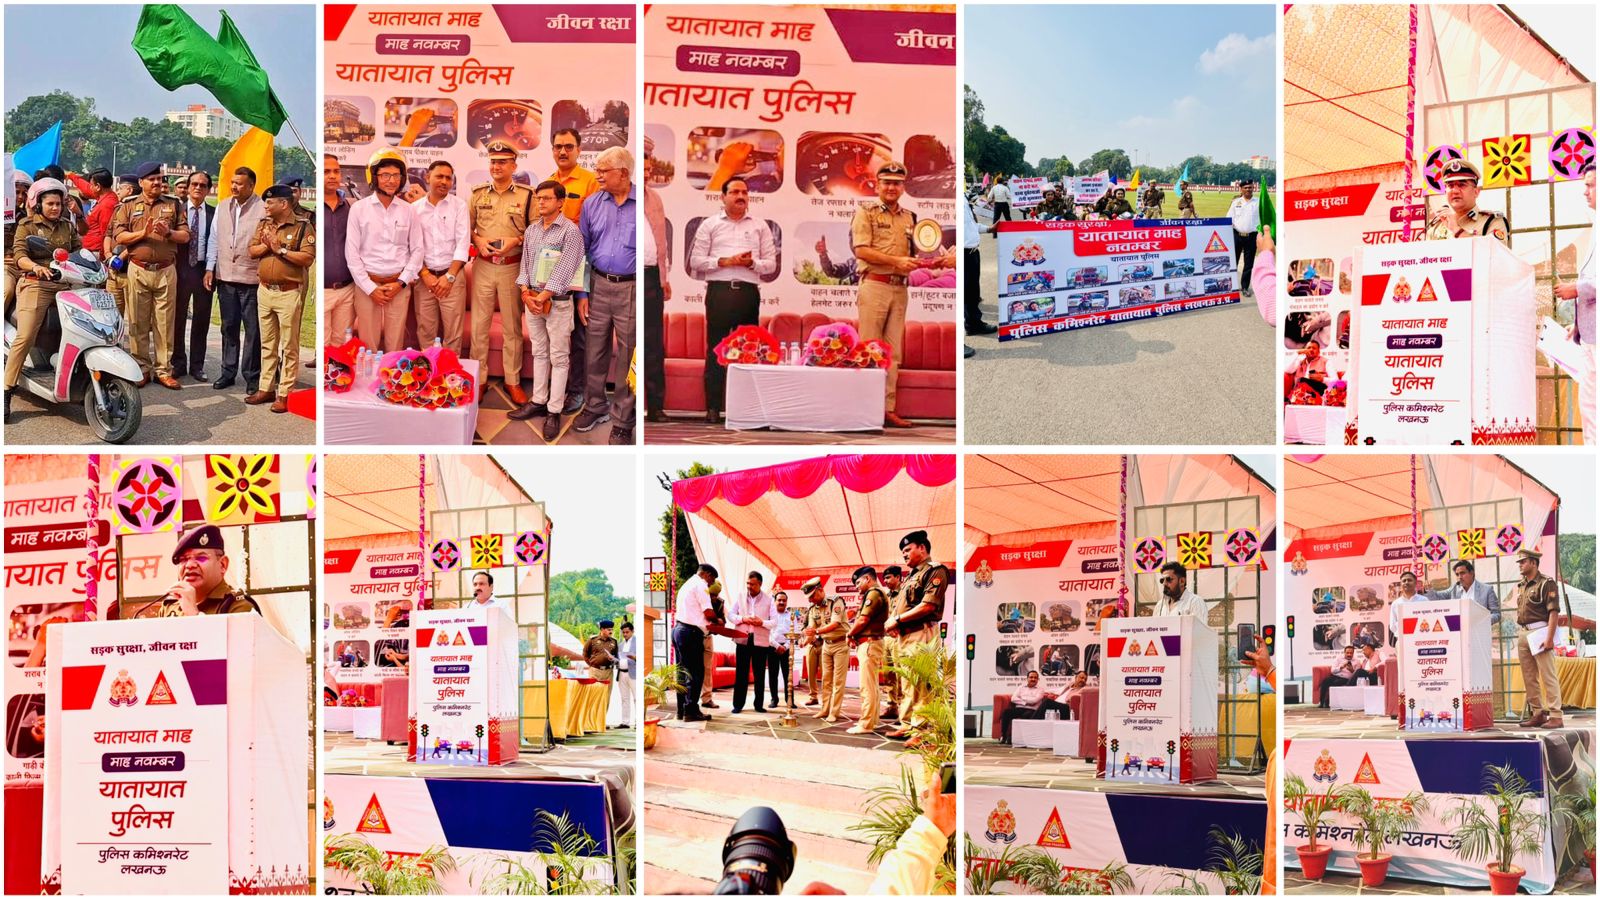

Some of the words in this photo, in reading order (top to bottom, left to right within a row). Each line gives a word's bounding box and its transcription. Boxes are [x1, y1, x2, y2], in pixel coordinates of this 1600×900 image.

[368, 11, 443, 27] यातायात
[447, 12, 482, 28] माह
[545, 13, 595, 30] जीवन
[597, 17, 632, 31] रक्षा
[666, 16, 764, 38] यातायात
[771, 22, 815, 42] माह
[384, 38, 410, 51] माह
[412, 38, 461, 51] नवम्बर
[894, 28, 956, 50] जीवन
[688, 51, 722, 67] माह
[725, 53, 788, 70] नवम्बर
[336, 63, 435, 84] यातायात
[437, 57, 515, 93] पुलिस
[644, 82, 754, 111] ातायात
[759, 79, 856, 122] पुलिस
[582, 136, 609, 144] STOP
[1294, 199, 1318, 211] सड़क
[1320, 195, 1349, 209] सुरक्षा
[1078, 229, 1150, 243] यातायात
[1153, 228, 1183, 239] माह
[1105, 241, 1162, 253] नवम्बर
[1140, 253, 1160, 262] पुलिस
[1009, 323, 1049, 339] पुलिस
[1052, 313, 1106, 331] कमिश्नरेट
[1110, 307, 1152, 322] यातायात
[1155, 303, 1182, 317] पुलिस
[1184, 298, 1216, 310] लखनऊ
[1382, 318, 1425, 330] यातायात
[1427, 317, 1448, 329] माह
[1392, 338, 1407, 346] माह
[1408, 337, 1436, 346] नवम्बर
[1384, 354, 1444, 368] यातायात
[1390, 371, 1435, 395] पुलिस
[1383, 402, 1404, 414] पुलिस
[1406, 402, 1444, 413] कमिश्नरेट
[1397, 415, 1429, 424] लखनऊ
[11, 531, 40, 546] माह
[1313, 543, 1331, 553] सड़क
[366, 553, 405, 563] यातायात
[1000, 552, 1021, 562] सड़क
[1023, 550, 1047, 561] सुरक्षा
[389, 567, 414, 575] नवम्बर
[1087, 562, 1101, 570] माह
[351, 582, 400, 594] यातायात
[1058, 577, 1116, 592] यातायात
[91, 645, 114, 657] सड़क
[149, 641, 176, 652] जीवन
[179, 640, 198, 651] रक्षा
[1416, 657, 1448, 666] यातायात
[1421, 666, 1443, 679] पुलिस
[433, 676, 470, 685] यातायात
[437, 686, 465, 701] पुलिस
[1123, 688, 1162, 698] यातायात
[1128, 699, 1156, 714] पुलिस
[94, 730, 158, 744] यातायात
[162, 729, 193, 744] माह
[110, 756, 131, 768] माह
[134, 755, 176, 767] नवम्बर
[99, 780, 187, 799] यातायात
[108, 803, 174, 837] पुलिस
[98, 846, 130, 863] पुलिस
[133, 847, 189, 860] कमिश्नरेट
[120, 864, 167, 875] लखनऊ
